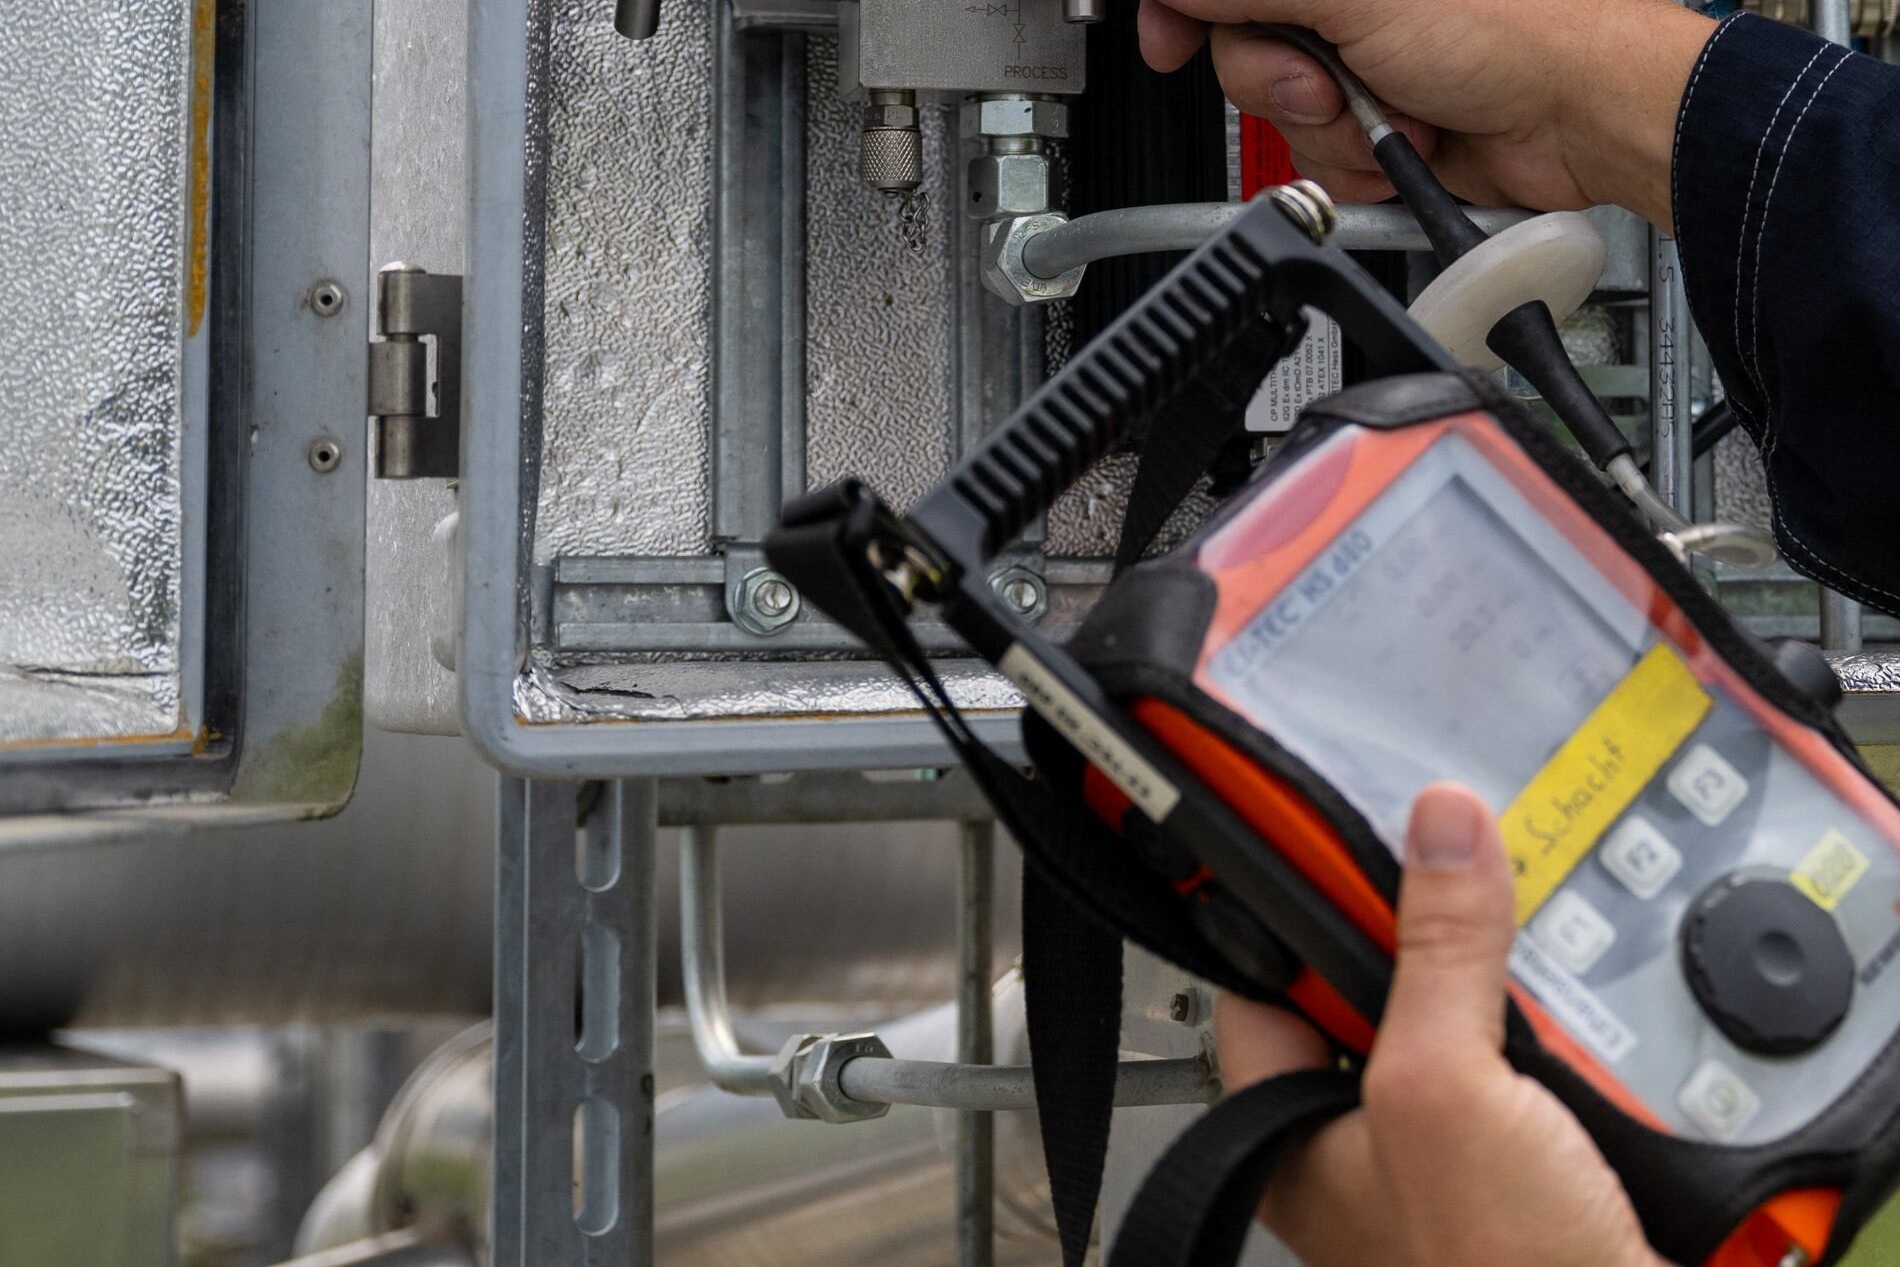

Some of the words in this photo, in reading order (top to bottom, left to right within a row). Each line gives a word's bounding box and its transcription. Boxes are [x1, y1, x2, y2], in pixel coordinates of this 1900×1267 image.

[1004, 65, 1068, 80] PROCESS
[1318, 346, 1326, 364] 1041
[1331, 350, 1339, 370] Hess
[1305, 366, 1314, 376] 07
[1318, 367, 1326, 390] ATEX
[1282, 378, 1290, 392] dm
[1305, 377, 1314, 395] PTB
[1282, 394, 1290, 404] Ex
[1270, 409, 1278, 422] CP
[1625, 840, 1659, 874] F2
